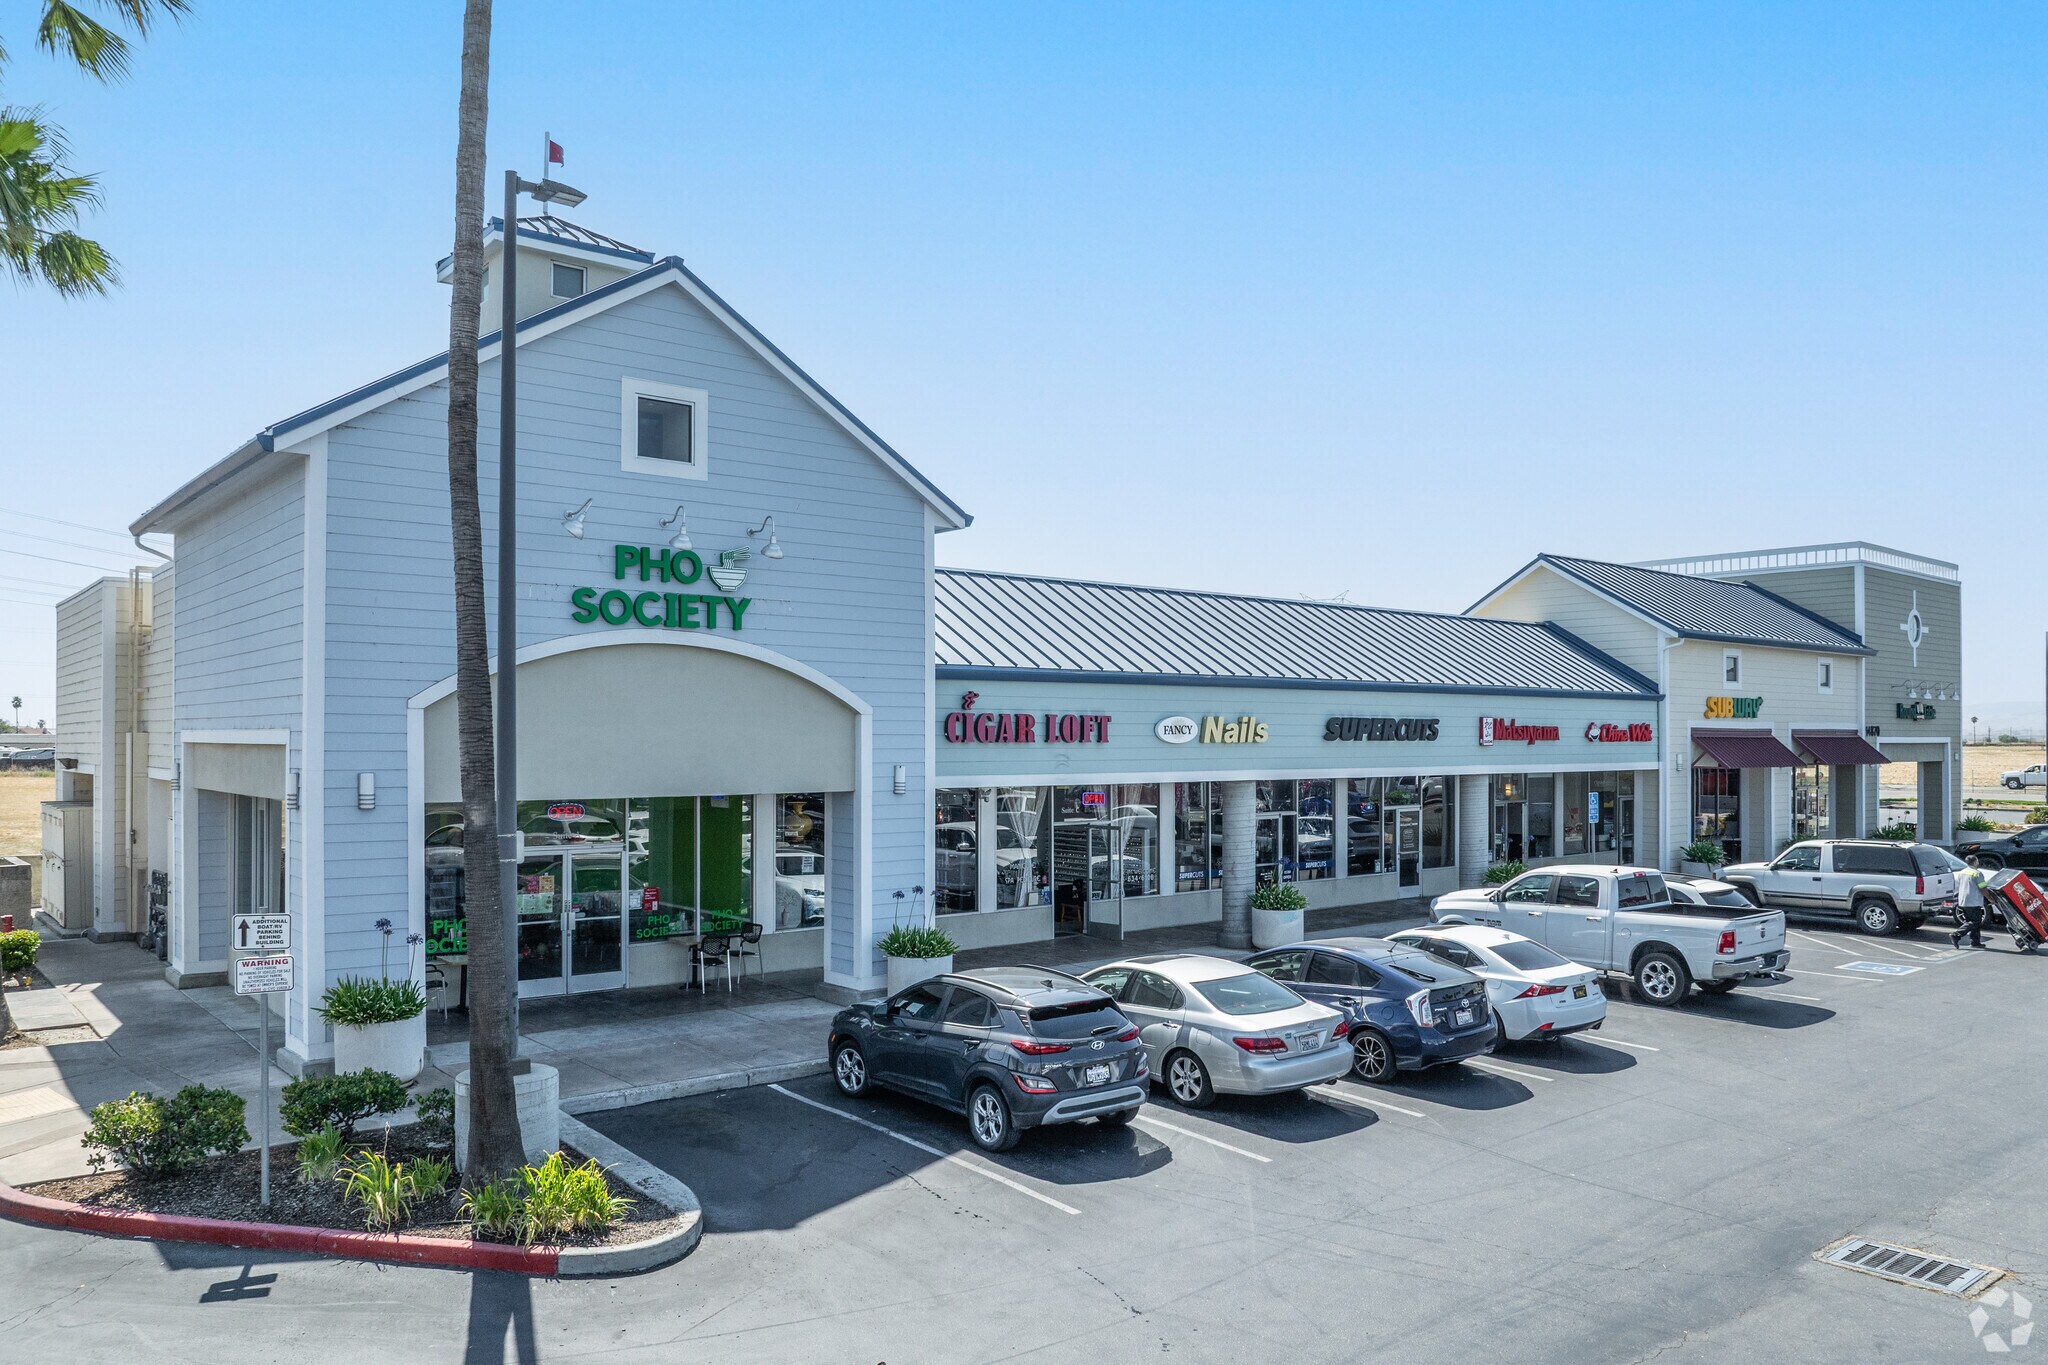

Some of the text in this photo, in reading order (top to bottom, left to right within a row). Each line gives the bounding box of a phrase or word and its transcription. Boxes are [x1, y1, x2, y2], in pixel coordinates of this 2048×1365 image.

[615, 544, 702, 584] PHO
[572, 587, 752, 630] SOCIETY
[1704, 696, 1763, 719] SUBWAY
[944, 712, 1112, 743] CIGAR LOFT
[1164, 725, 1193, 735] FANCY
[1199, 716, 1269, 743] Nails
[1323, 717, 1440, 741] SUPERCUTS
[1493, 718, 1560, 745] Matsuyama
[1600, 723, 1652, 742] China Wok
[1084, 794, 1104, 804] OPEN
[550, 806, 582, 818] OPEN
[1179, 870, 1204, 879] SUPERCUTS
[648, 914, 670, 925] PHO
[712, 909, 732, 919] PHO
[426, 937, 468, 954] OCIE
[242, 958, 288, 967] WARNING
